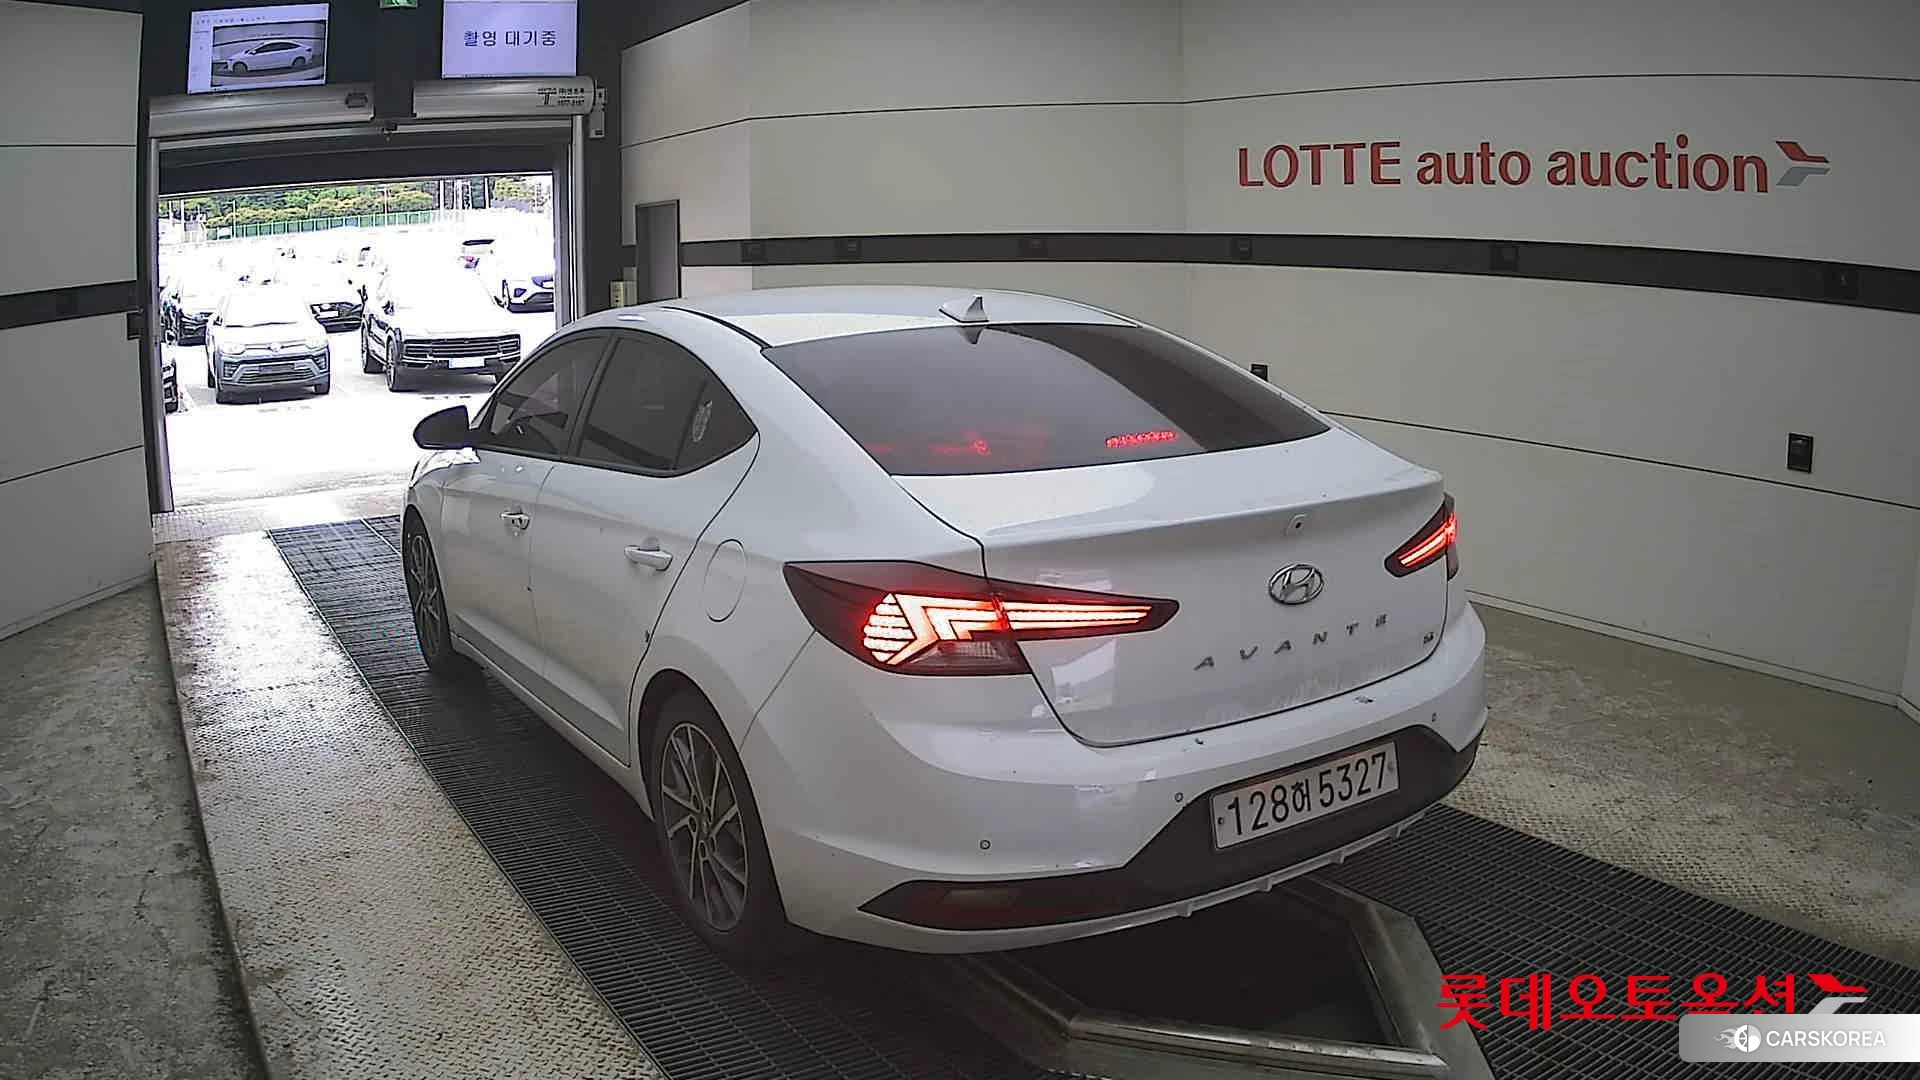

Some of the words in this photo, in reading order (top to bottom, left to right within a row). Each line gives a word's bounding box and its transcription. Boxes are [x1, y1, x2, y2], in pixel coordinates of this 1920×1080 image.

[464, 30, 497, 47] 촬영
[505, 30, 557, 47] 대기중
[1239, 142, 1400, 187] LOTTE
[1418, 141, 1532, 187] auto
[1548, 134, 1768, 193] auction
[1193, 613, 1389, 671] AVANTE
[1318, 751, 1387, 809] 5327
